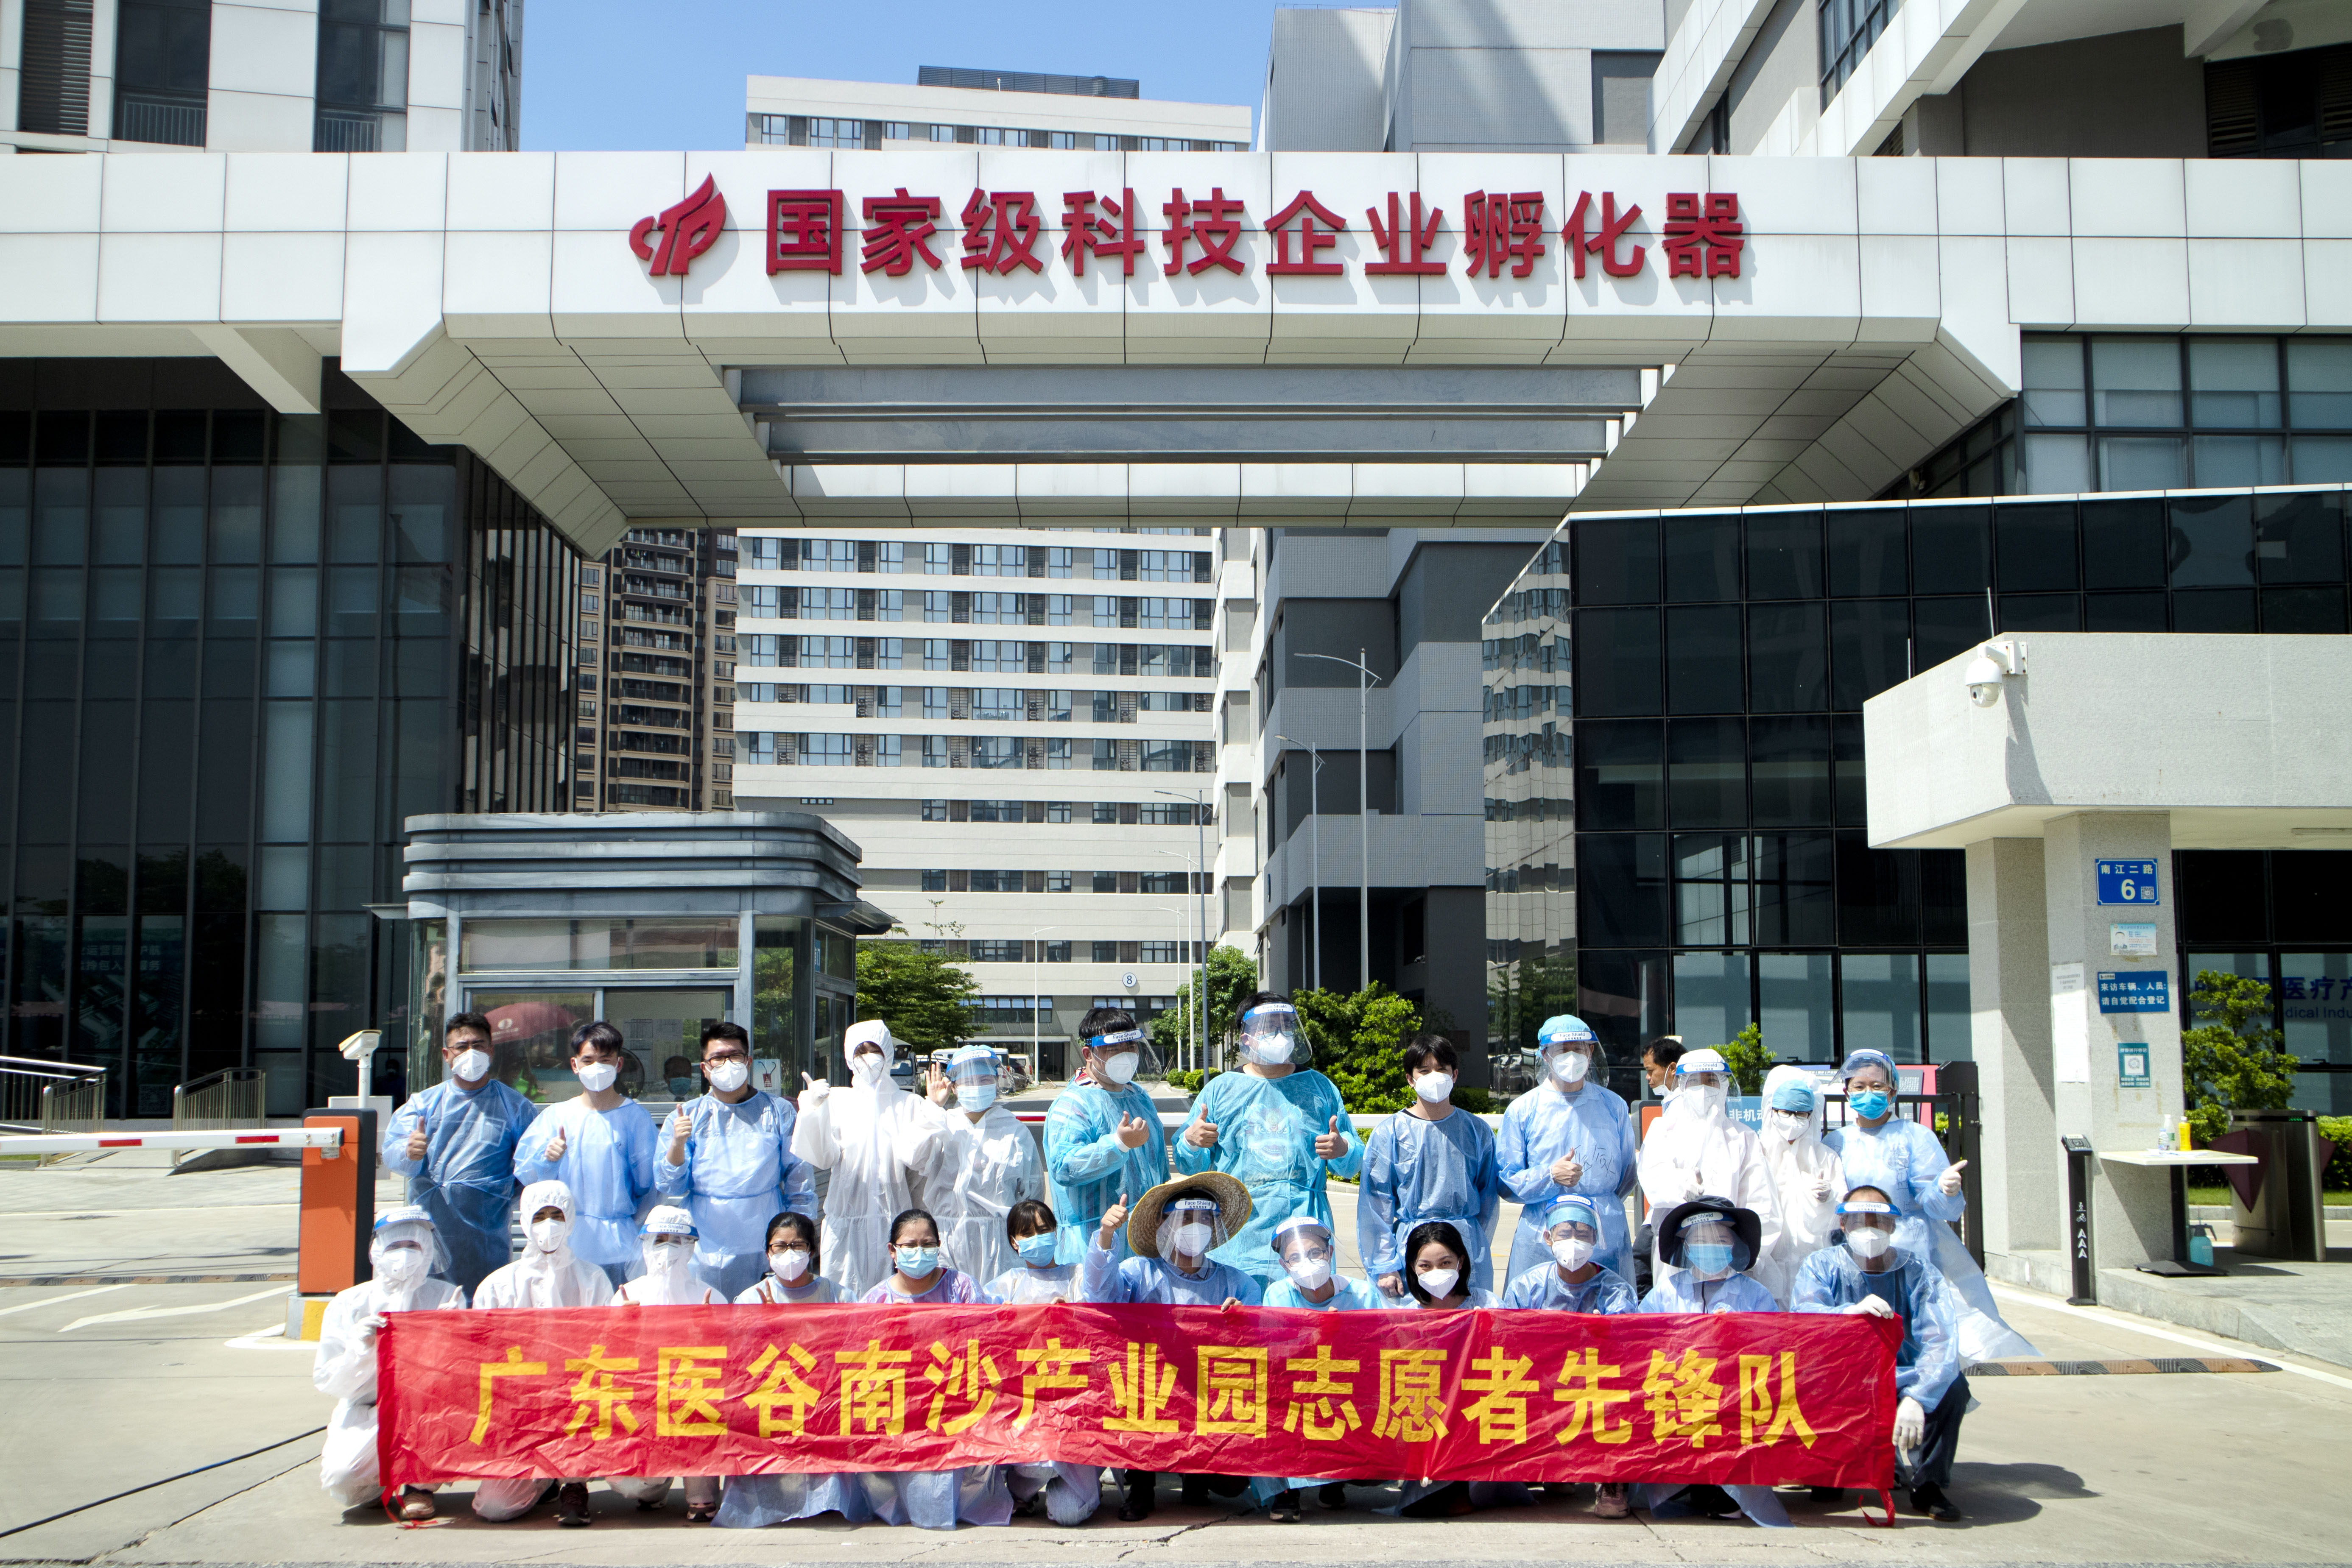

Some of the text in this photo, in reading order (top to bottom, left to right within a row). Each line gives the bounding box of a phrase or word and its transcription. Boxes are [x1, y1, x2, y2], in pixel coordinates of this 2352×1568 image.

[766, 188, 1745, 279] 国家级科技企业孵化器
[2101, 864, 2153, 874] 南江二路
[2121, 879, 2136, 900] 6
[1126, 975, 1132, 984] 8
[2101, 996, 2165, 1005] 请自觉配合登记
[469, 1336, 1818, 1449] 广东医谷南沙产业园志愿者先锋队
